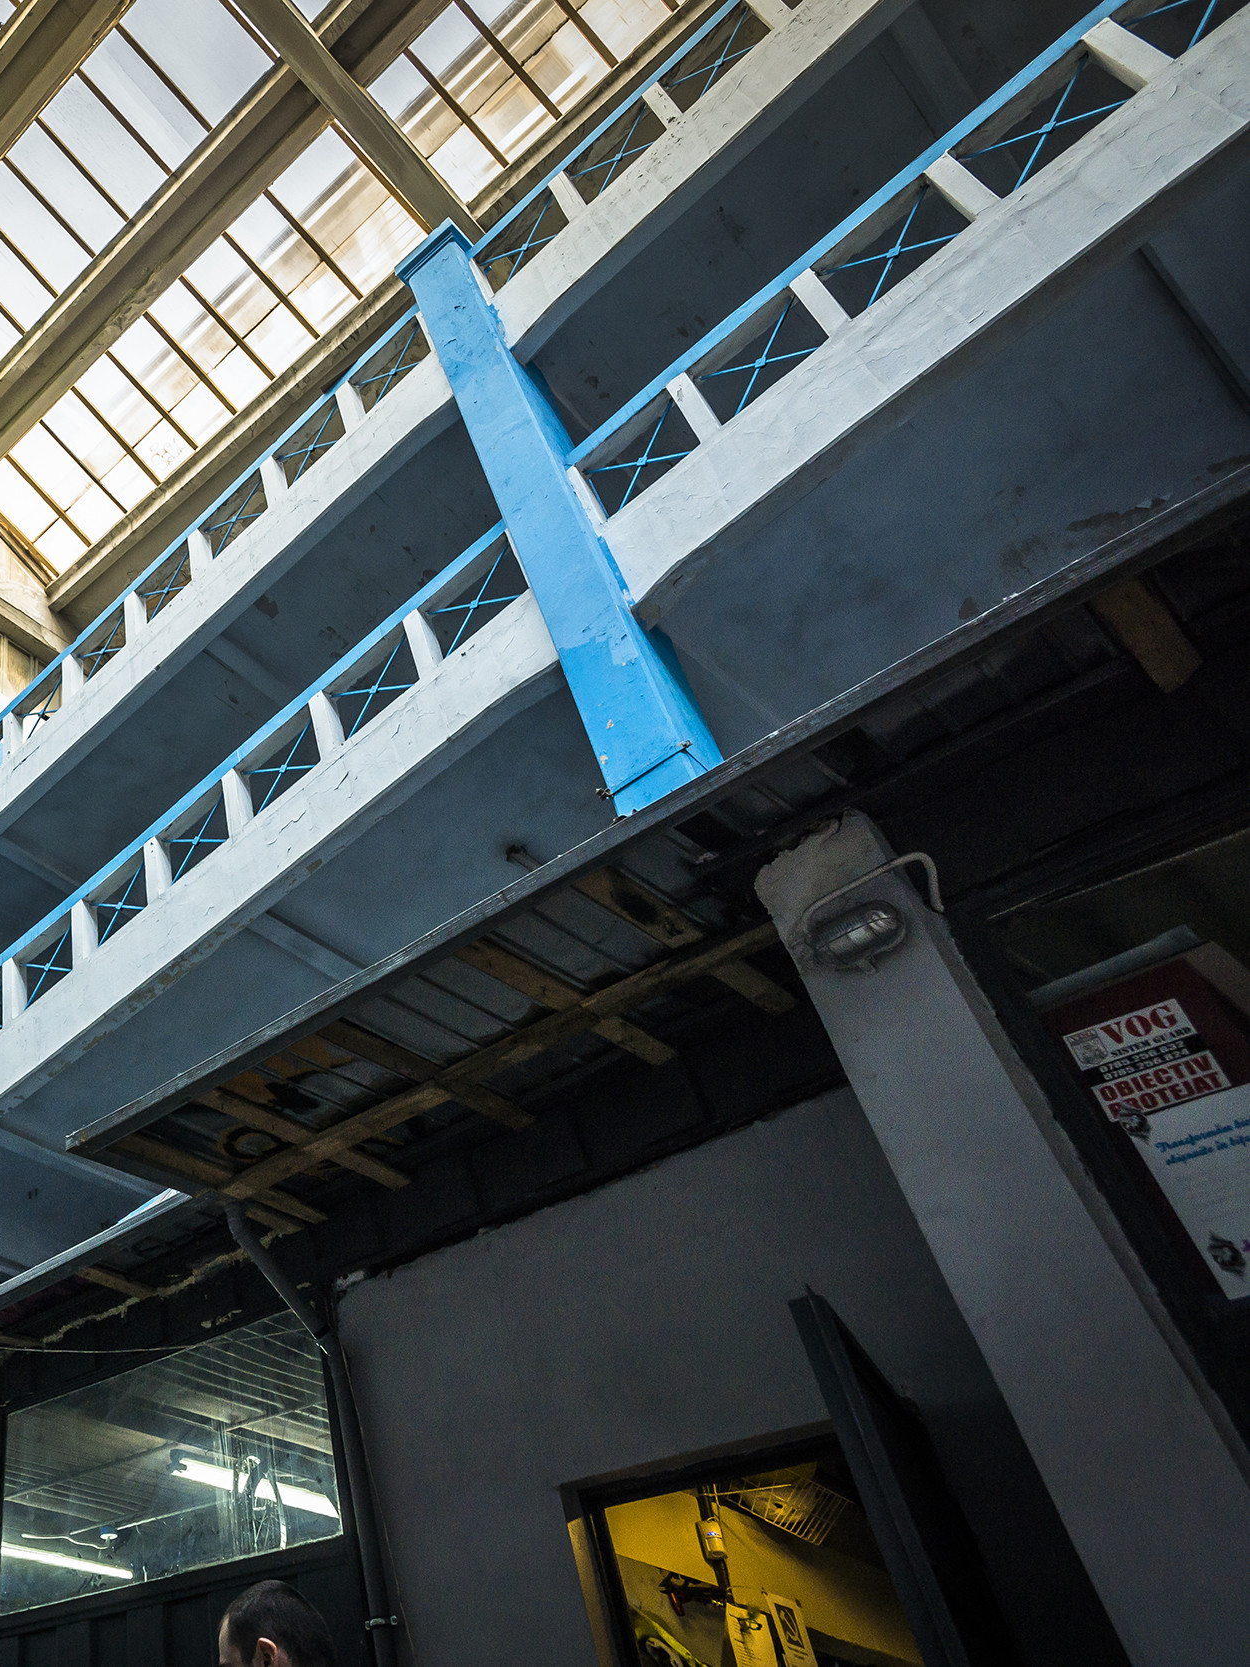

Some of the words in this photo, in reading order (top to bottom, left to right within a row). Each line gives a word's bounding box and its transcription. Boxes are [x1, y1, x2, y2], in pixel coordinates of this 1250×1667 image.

[1100, 1005, 1178, 1045] VOG
[1110, 1041, 1150, 1057] SISTEM
[1153, 1027, 1192, 1044] GUARD
[1100, 1054, 1214, 1102] OBIECTIV
